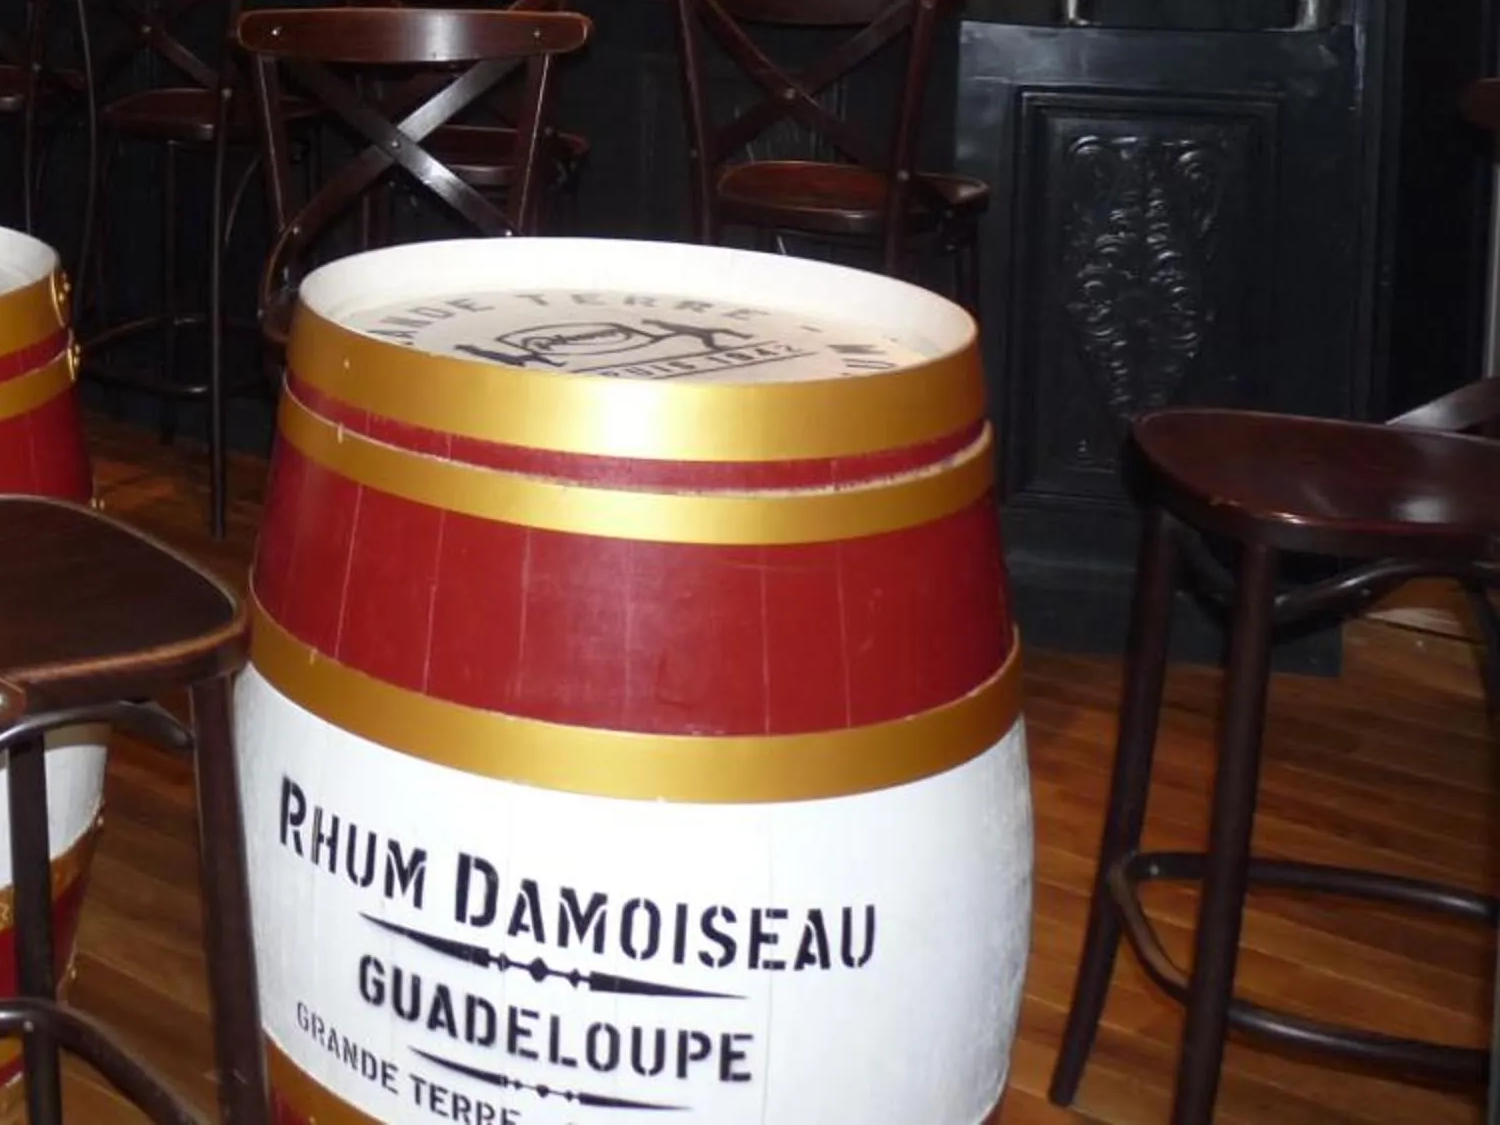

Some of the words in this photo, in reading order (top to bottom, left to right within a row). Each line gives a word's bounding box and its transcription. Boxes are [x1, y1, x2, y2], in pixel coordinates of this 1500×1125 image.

[367, 297, 497, 347] ANDE
[514, 292, 772, 321] TERRE
[279, 776, 427, 909] RHUM
[453, 852, 877, 972] DAMOISEAU
[296, 1001, 399, 1095] GRANDE
[358, 954, 755, 1083] GUADELOUPE
